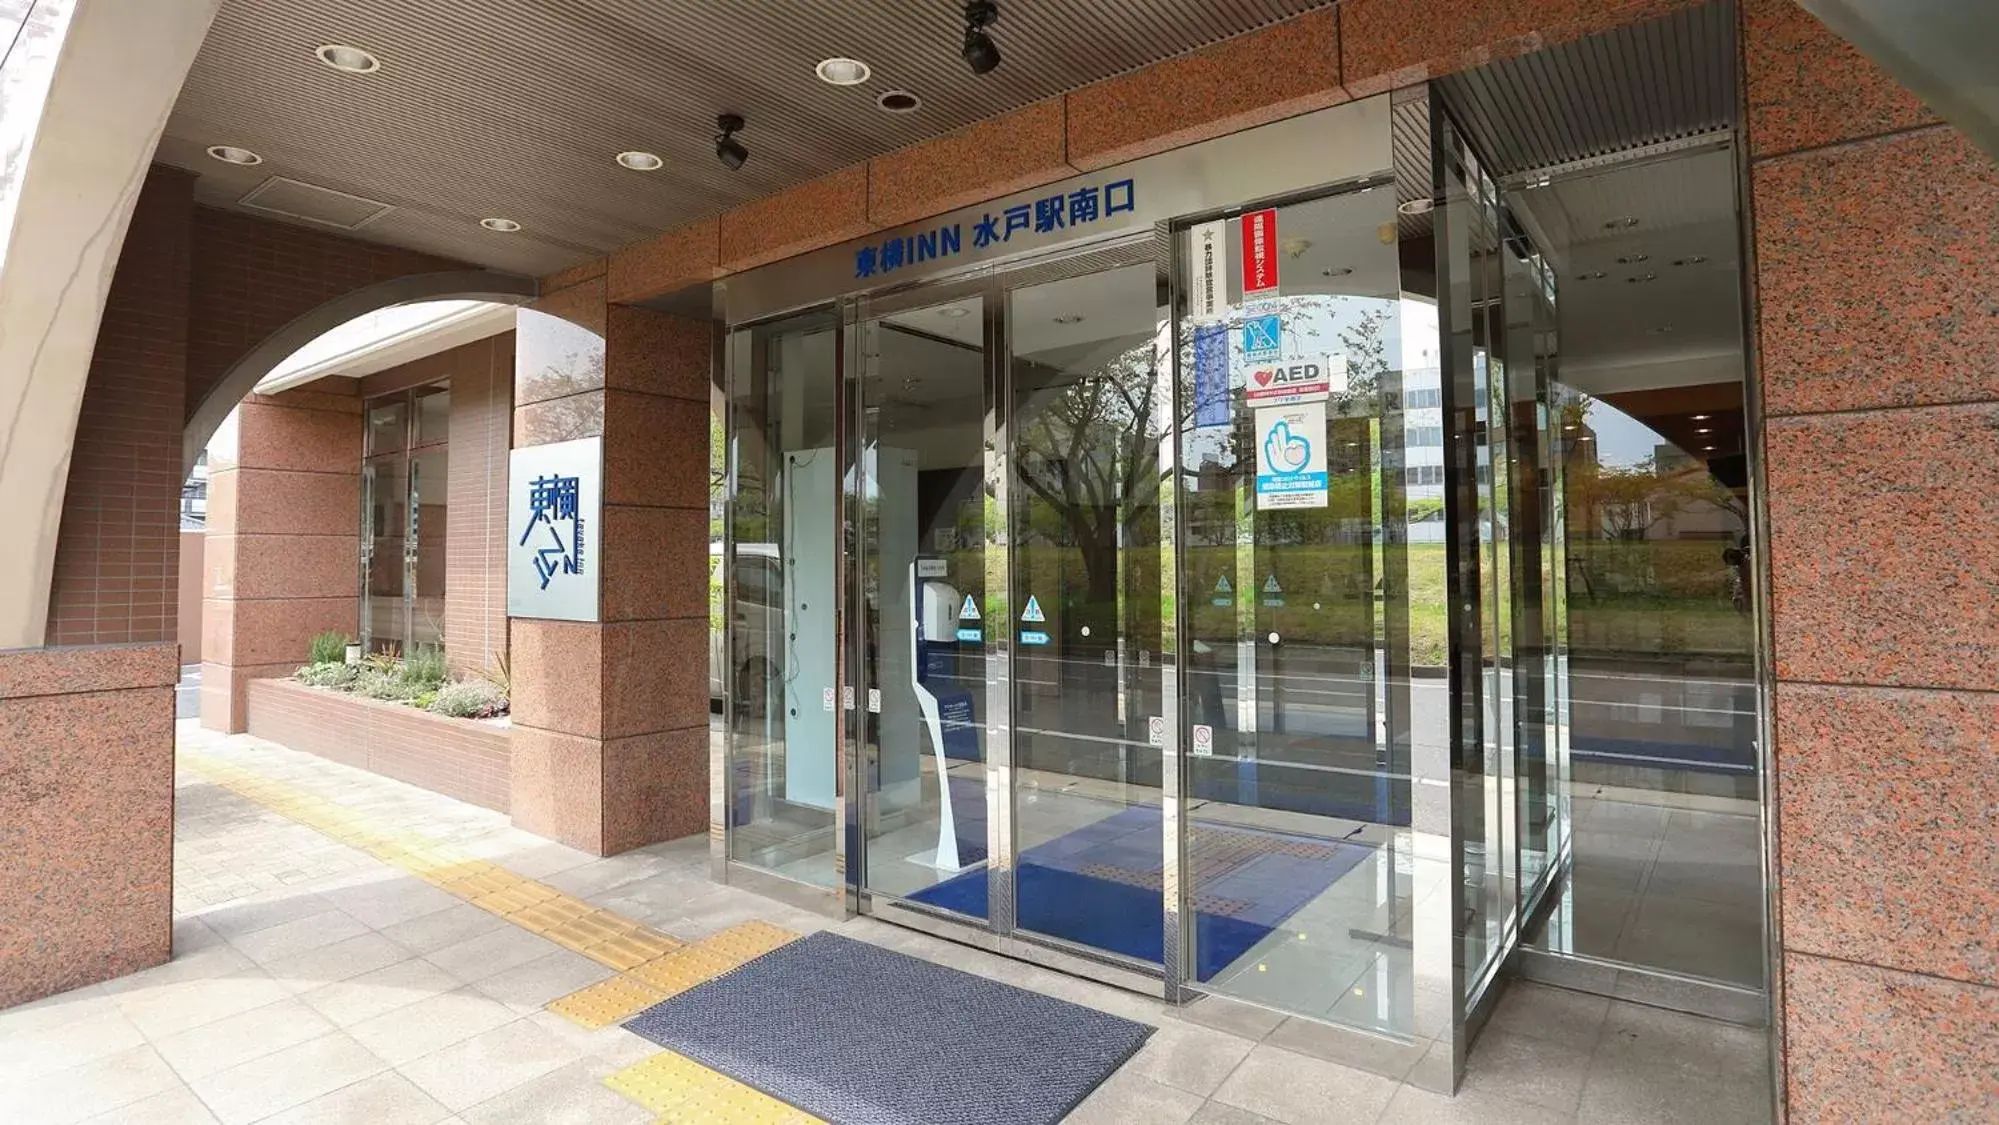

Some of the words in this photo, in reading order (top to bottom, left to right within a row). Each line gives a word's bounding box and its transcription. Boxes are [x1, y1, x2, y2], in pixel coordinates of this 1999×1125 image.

[855, 223, 961, 279] 東横INN
[973, 179, 1136, 248] 水戸駅南口
[1273, 364, 1320, 383] AED
